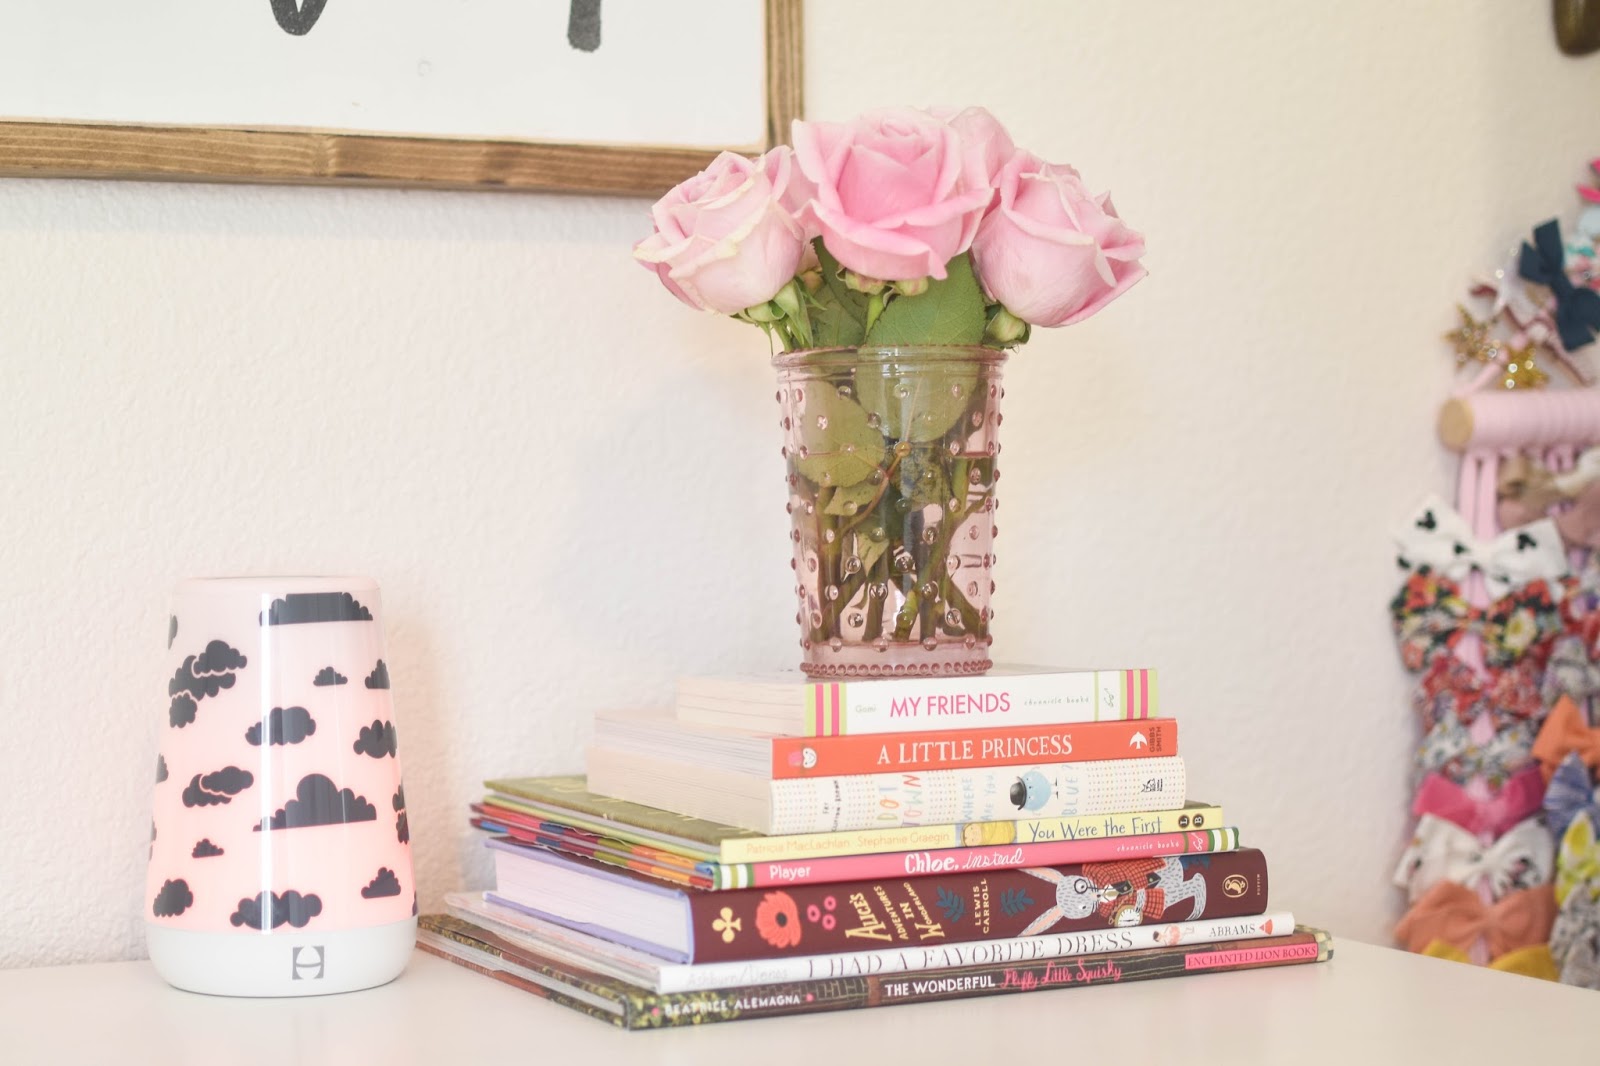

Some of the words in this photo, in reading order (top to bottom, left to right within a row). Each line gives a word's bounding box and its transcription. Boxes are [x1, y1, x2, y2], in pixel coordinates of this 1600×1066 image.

[855, 704, 877, 714] Gomi
[890, 696, 922, 718] MY
[927, 692, 1011, 716] FRIENDS
[1024, 697, 1062, 707] chronicle
[1066, 696, 1090, 705] books
[877, 745, 891, 765] A
[898, 740, 974, 764] LITTLE
[981, 733, 1073, 759] PRINCESS
[961, 776, 975, 821] WHERE
[858, 833, 907, 848] Stephanie
[1028, 820, 1055, 843] You
[1060, 820, 1098, 841] Were
[1103, 817, 1126, 837] the
[1131, 815, 1163, 835] First
[787, 837, 850, 852] MacLachlan
[1116, 842, 1154, 852] chronicle
[1157, 840, 1180, 850] books
[769, 863, 811, 881] Player
[904, 850, 960, 874] Chloe,
[962, 848, 1026, 869] instead
[873, 885, 909, 940] ADVENTURES
[899, 902, 915, 920] IN
[972, 885, 982, 926] LEWIS
[980, 878, 990, 934] CARROLL
[1208, 923, 1256, 938] ABRAMS
[829, 954, 883, 976] HAD
[895, 951, 909, 970] A
[921, 938, 1046, 968] FAVORITE
[1055, 931, 1135, 956] DRESS
[1187, 952, 1254, 967] ENCHANTED
[1255, 948, 1281, 961] LION
[1282, 944, 1318, 959] BOOKS
[884, 982, 910, 997] THE
[912, 975, 996, 995] WONDERFUL
[1000, 967, 1038, 991] Fluffy
[1041, 960, 1073, 984] Little
[1077, 958, 1122, 984] Squishy
[664, 999, 728, 1017] BEATRICE
[734, 994, 801, 1010] ALEMAGNA
